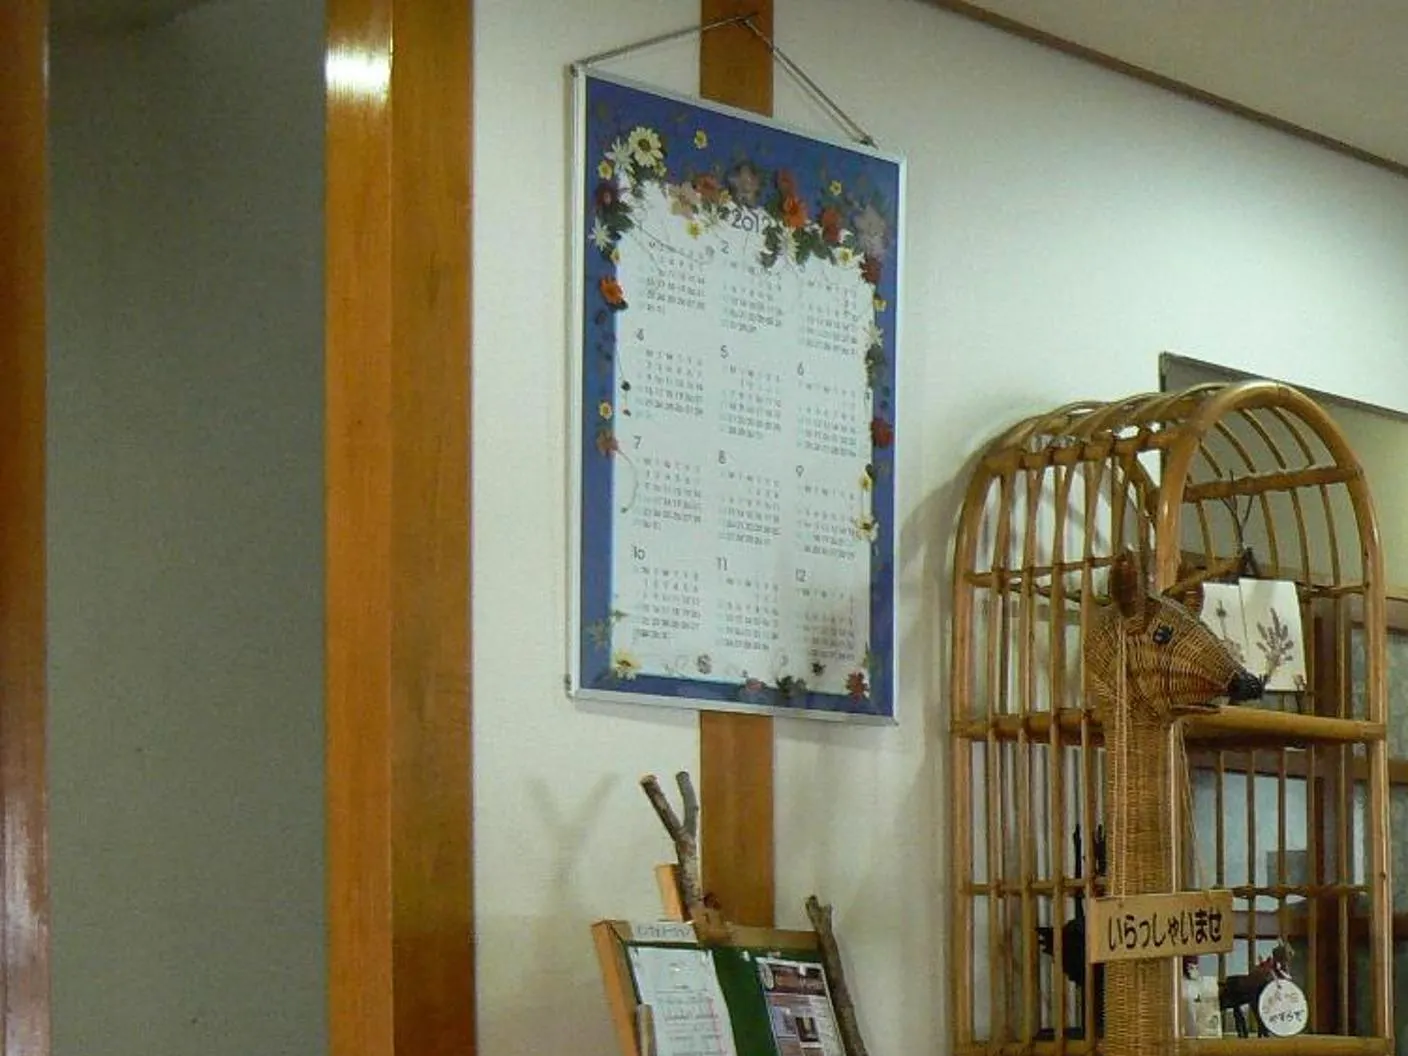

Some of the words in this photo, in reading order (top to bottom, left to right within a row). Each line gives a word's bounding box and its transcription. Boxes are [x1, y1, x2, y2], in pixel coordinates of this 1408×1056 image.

[1107, 906, 1223, 951] いらっしゃいませ
